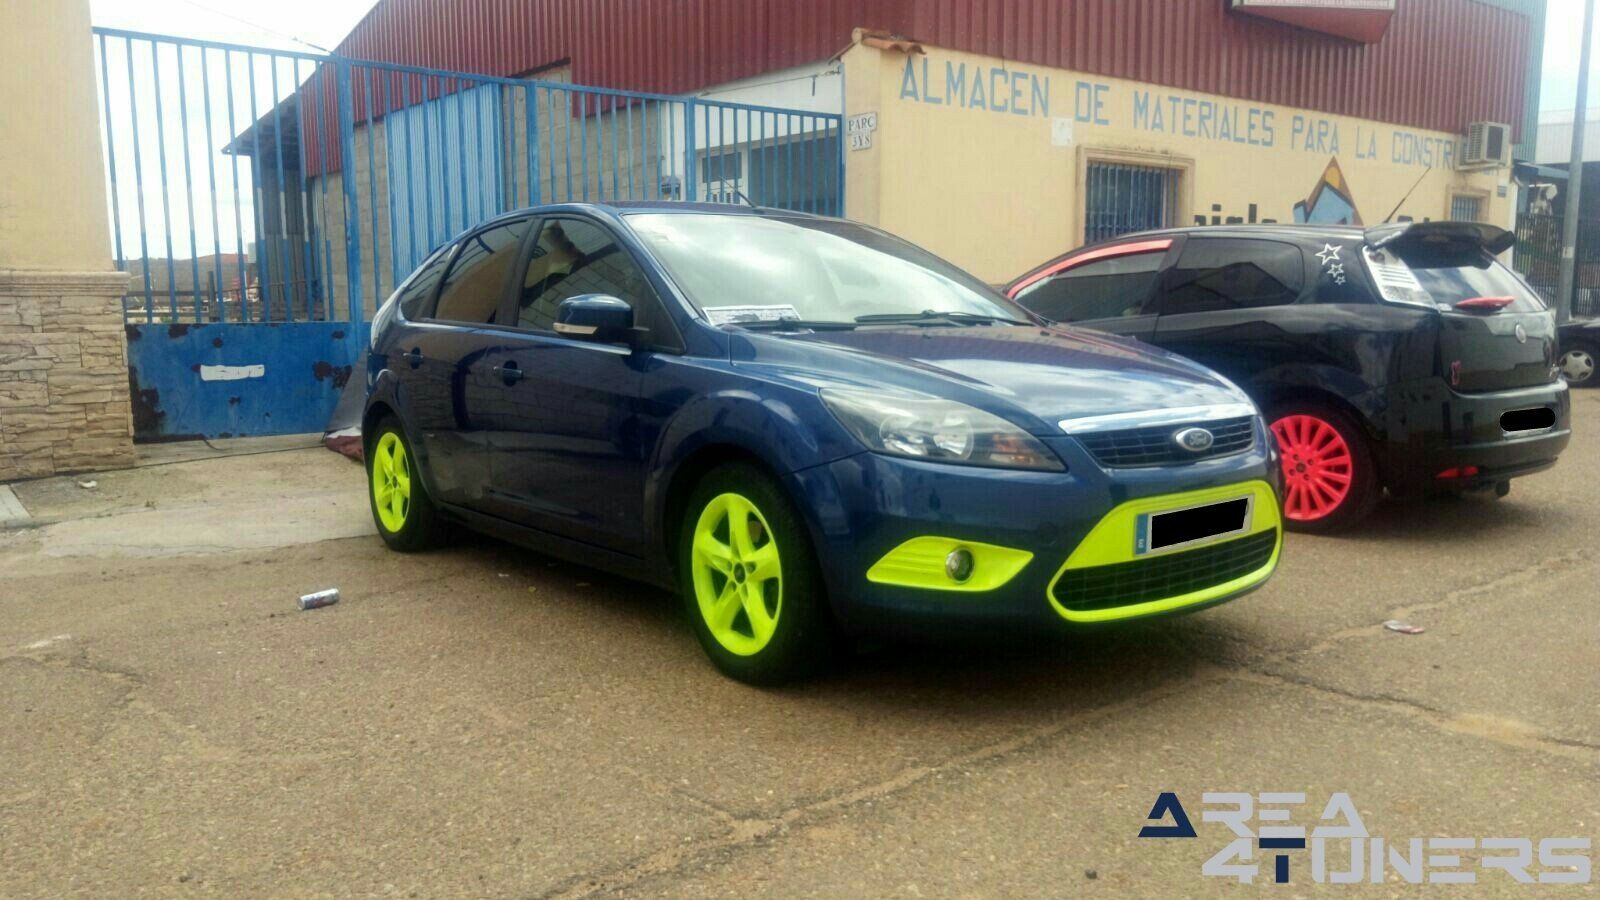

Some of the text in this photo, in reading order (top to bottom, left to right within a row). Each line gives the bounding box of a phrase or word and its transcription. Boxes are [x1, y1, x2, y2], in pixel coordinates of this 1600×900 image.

[900, 55, 1456, 170] ALMACEN DE MATERIALES PARA LA CONSTR
